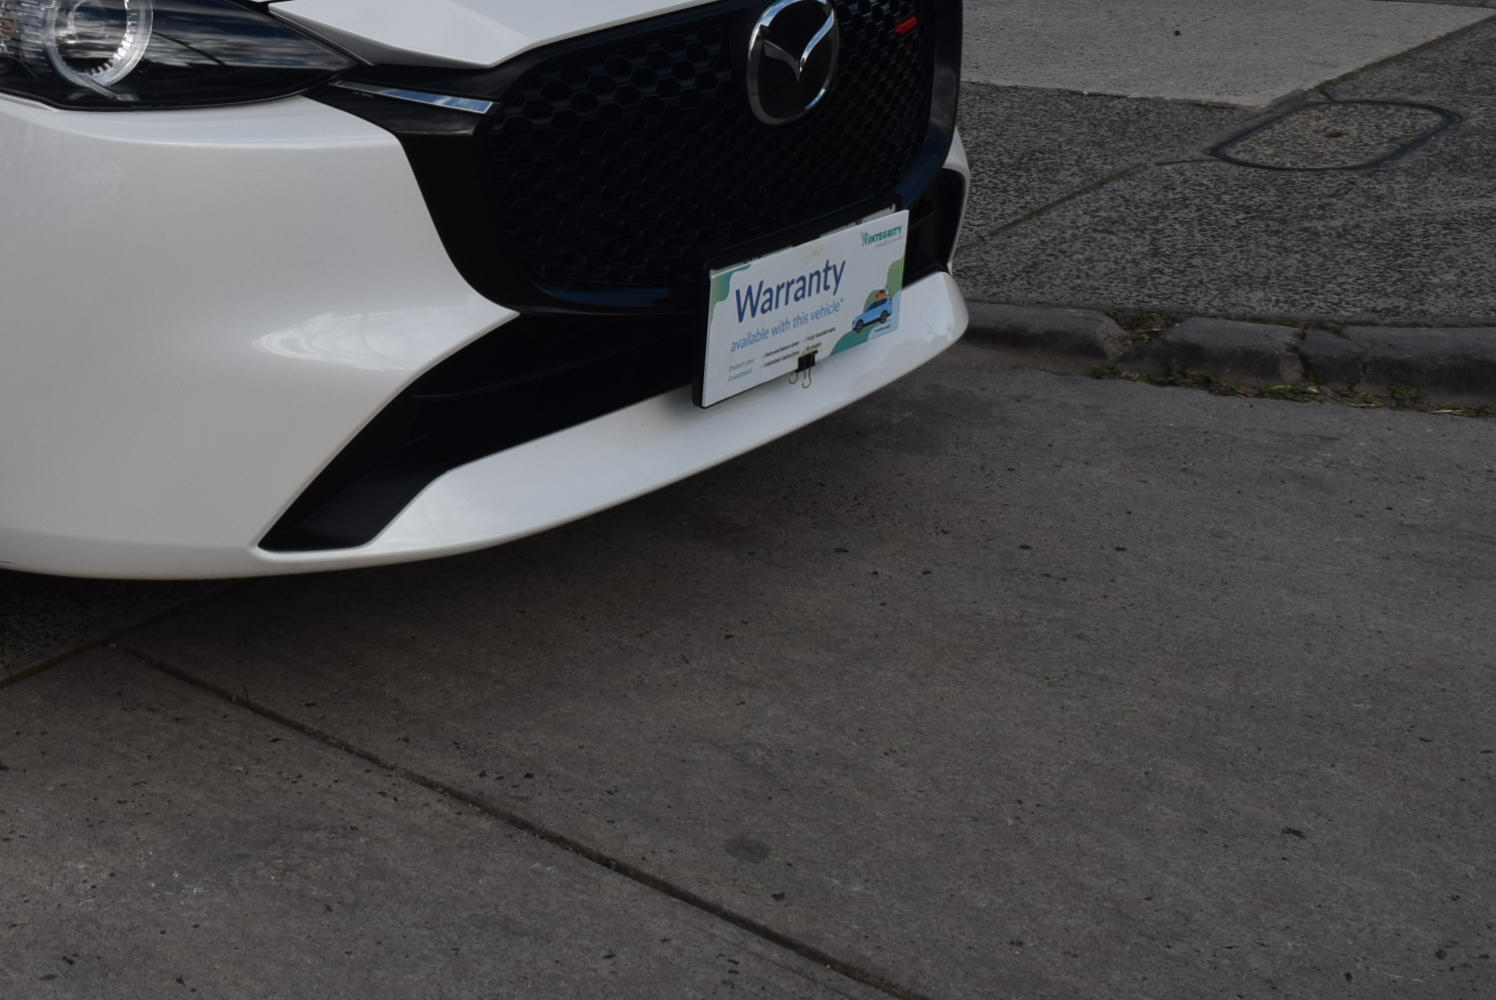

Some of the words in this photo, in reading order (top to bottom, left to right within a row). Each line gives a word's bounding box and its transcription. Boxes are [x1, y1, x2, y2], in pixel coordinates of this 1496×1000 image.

[735, 259, 846, 324] Warranty
[730, 327, 770, 353] available
[771, 317, 792, 337] with
[792, 310, 810, 329] this
